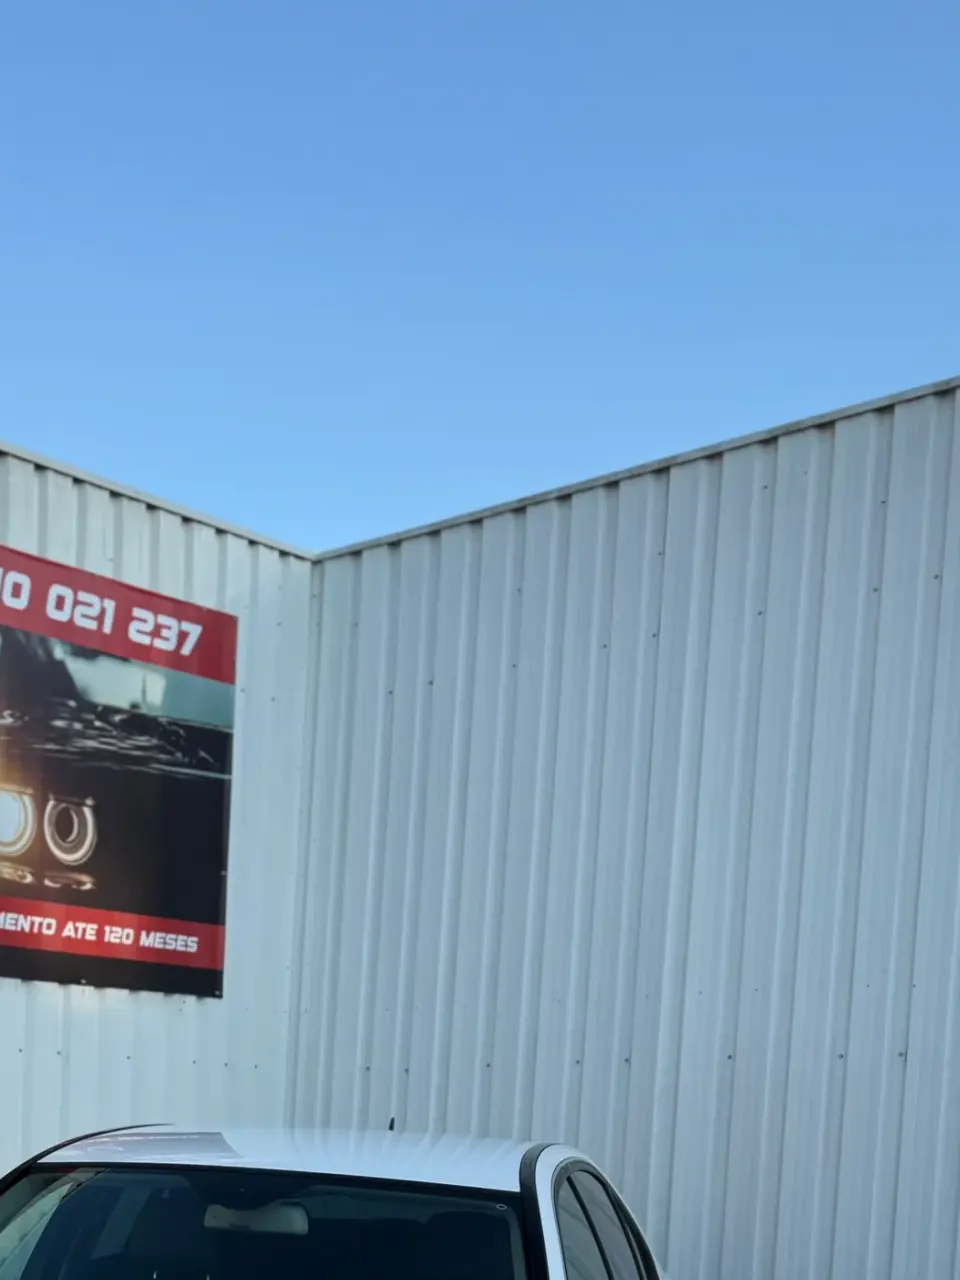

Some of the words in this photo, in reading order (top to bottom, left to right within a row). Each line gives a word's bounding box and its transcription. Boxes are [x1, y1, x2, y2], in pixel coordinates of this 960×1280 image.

[45, 584, 116, 635] 021
[127, 606, 203, 656] 237
[62, 921, 98, 940] ATE
[103, 926, 134, 945] 120
[139, 931, 199, 953] MESES
